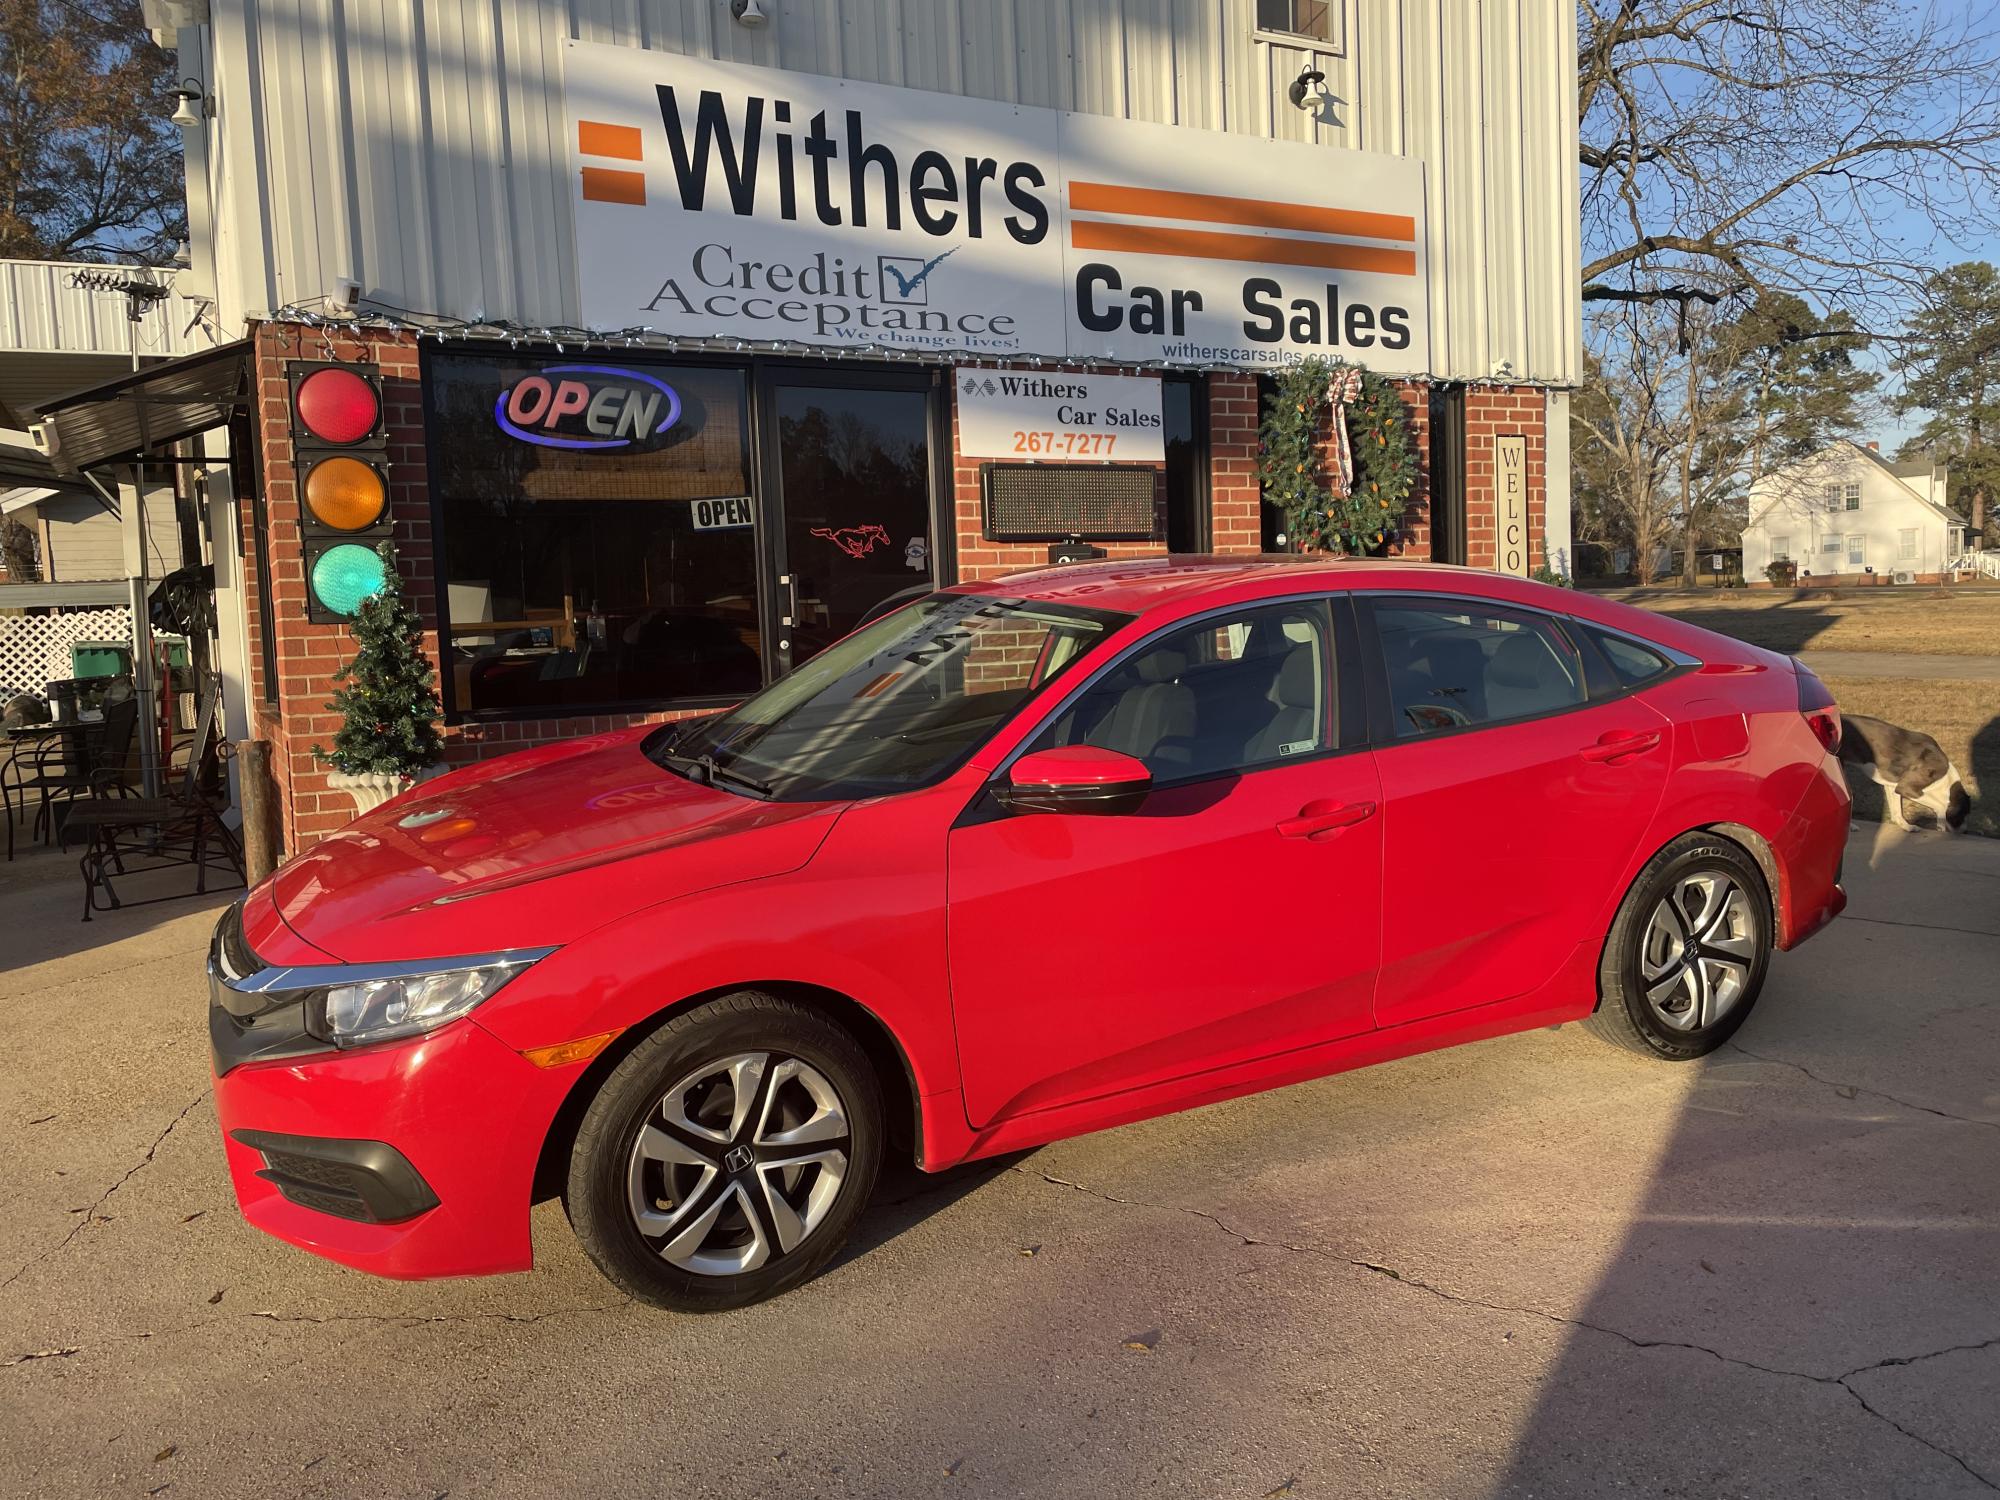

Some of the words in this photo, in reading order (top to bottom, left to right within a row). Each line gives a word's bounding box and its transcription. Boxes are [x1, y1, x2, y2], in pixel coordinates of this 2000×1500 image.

[655, 84, 1049, 245] Withers
[692, 243, 875, 300] Credit
[639, 278, 1016, 336] Acceptance
[1076, 263, 1203, 336] Car
[1242, 277, 1411, 350] Sales
[834, 327, 869, 341] We
[877, 331, 957, 347] change
[965, 335, 1020, 349] lives!
[508, 376, 662, 440] OPEN
[1000, 376, 1088, 398] Withers
[1013, 431, 1117, 455] 267-7277
[1057, 405, 1097, 425] Car
[1106, 407, 1161, 427] Sales
[697, 498, 752, 526] OPEN
[1502, 448, 1520, 570] WELCO
